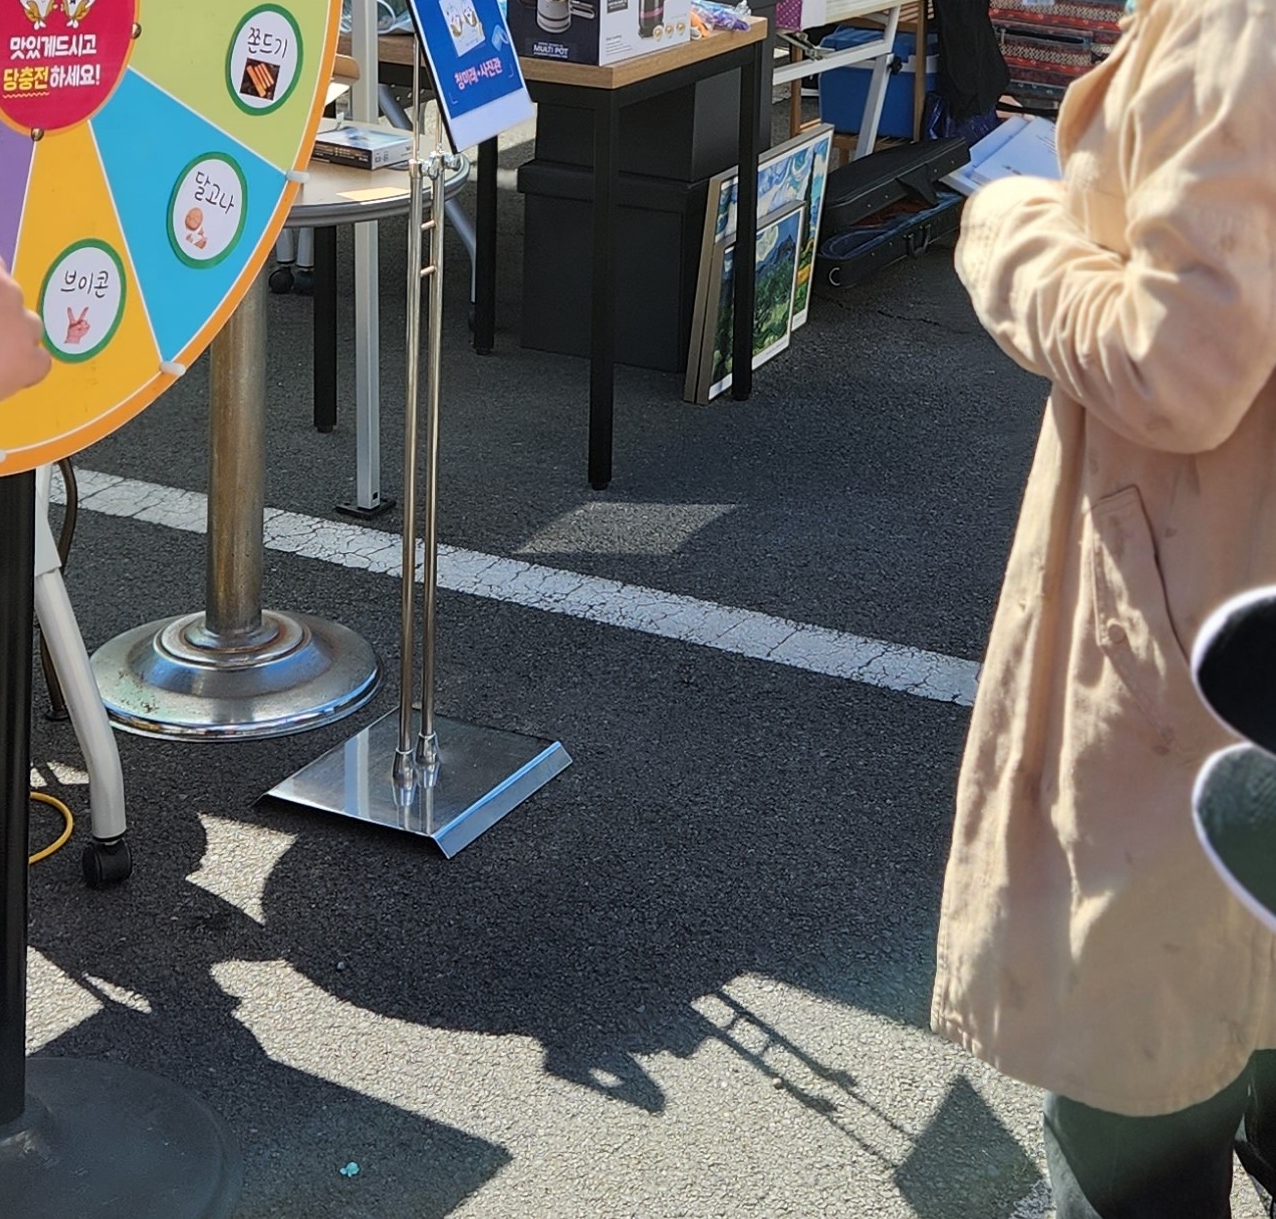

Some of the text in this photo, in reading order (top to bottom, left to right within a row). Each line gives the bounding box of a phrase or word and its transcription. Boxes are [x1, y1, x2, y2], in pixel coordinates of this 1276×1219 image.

[10, 34, 97, 60] 맛있게드시고
[247, 27, 288, 58] 쫀드기
[533, 43, 554, 53] MULTI
[554, 47, 569, 55] POT
[3, 64, 101, 91] 당충전하세요!
[194, 171, 235, 214] 달고나
[60, 270, 109, 298] 브이콘
